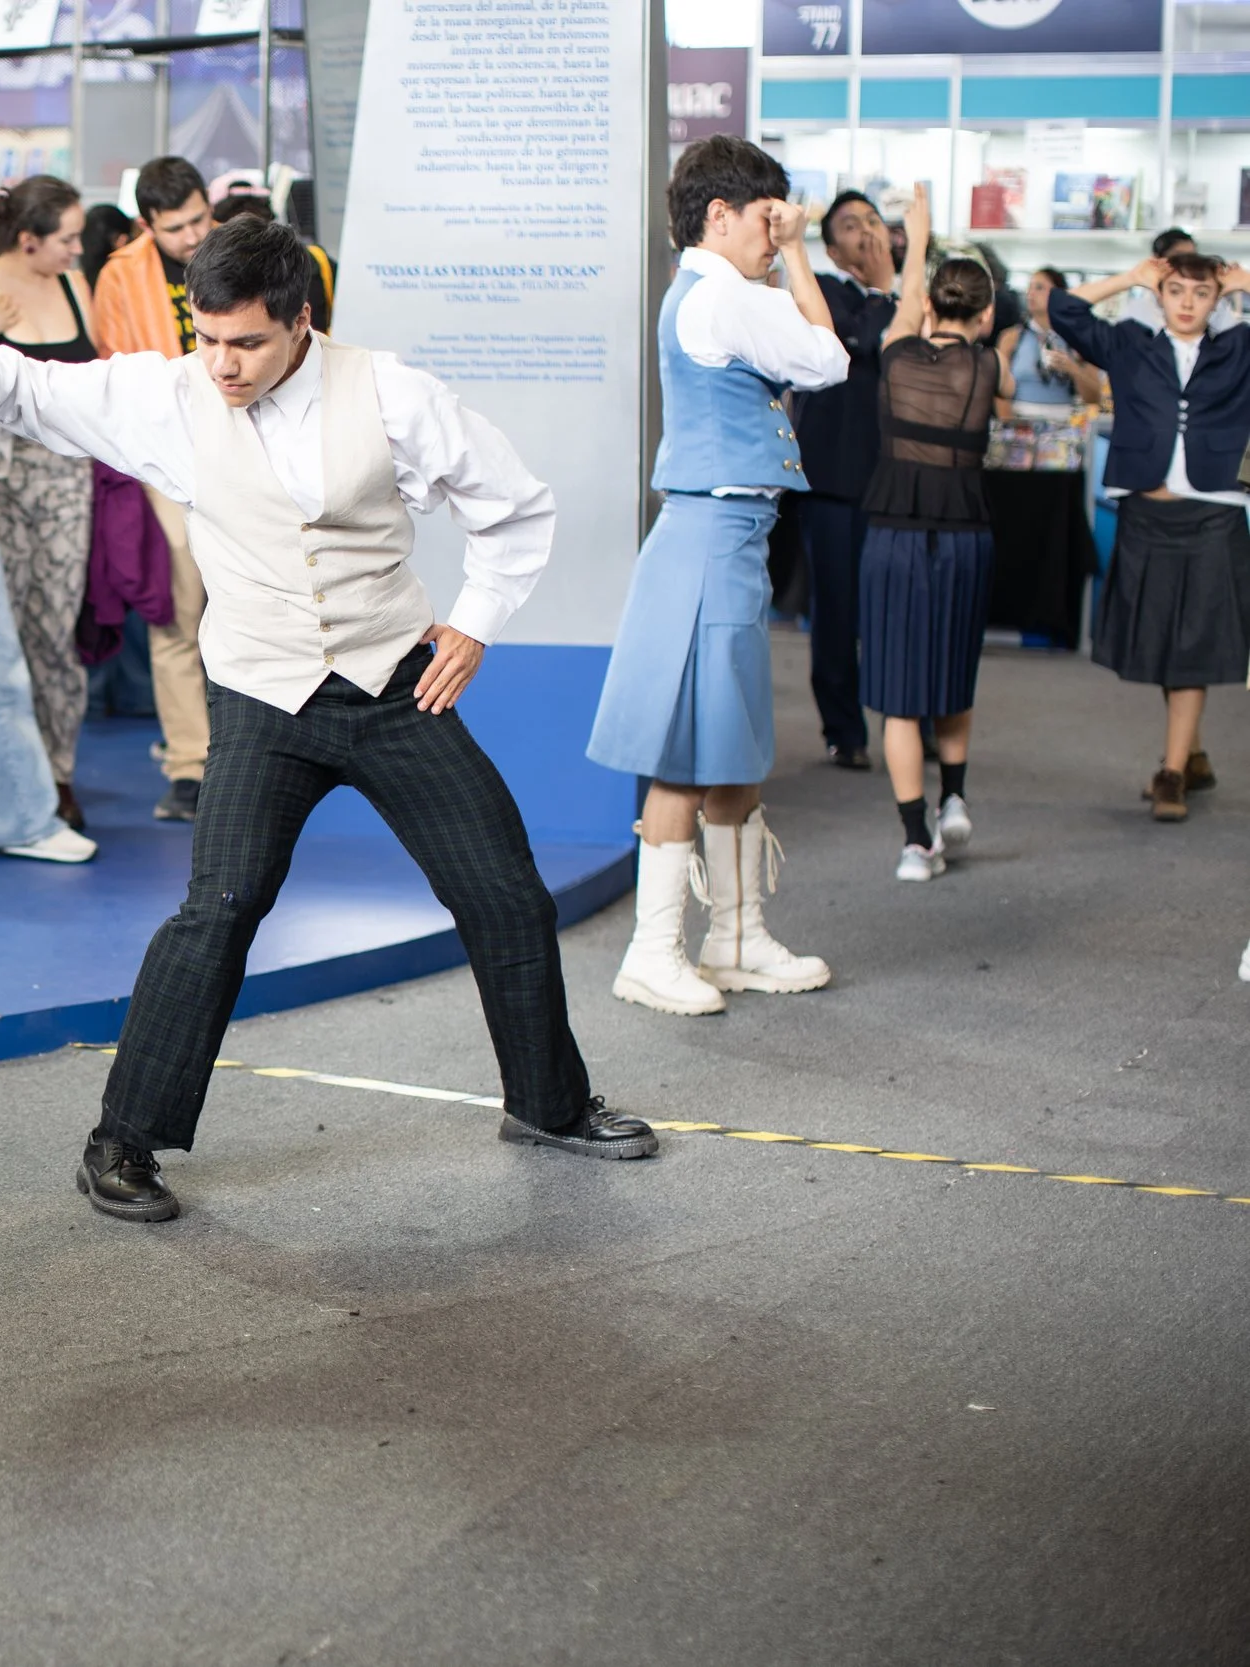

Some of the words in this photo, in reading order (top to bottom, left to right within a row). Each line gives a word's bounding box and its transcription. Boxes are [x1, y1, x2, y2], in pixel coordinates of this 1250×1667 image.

[810, 22, 842, 50] 77
[423, 264, 449, 278] LAS
[452, 264, 526, 278] VERDADES
[529, 264, 545, 278] SE
